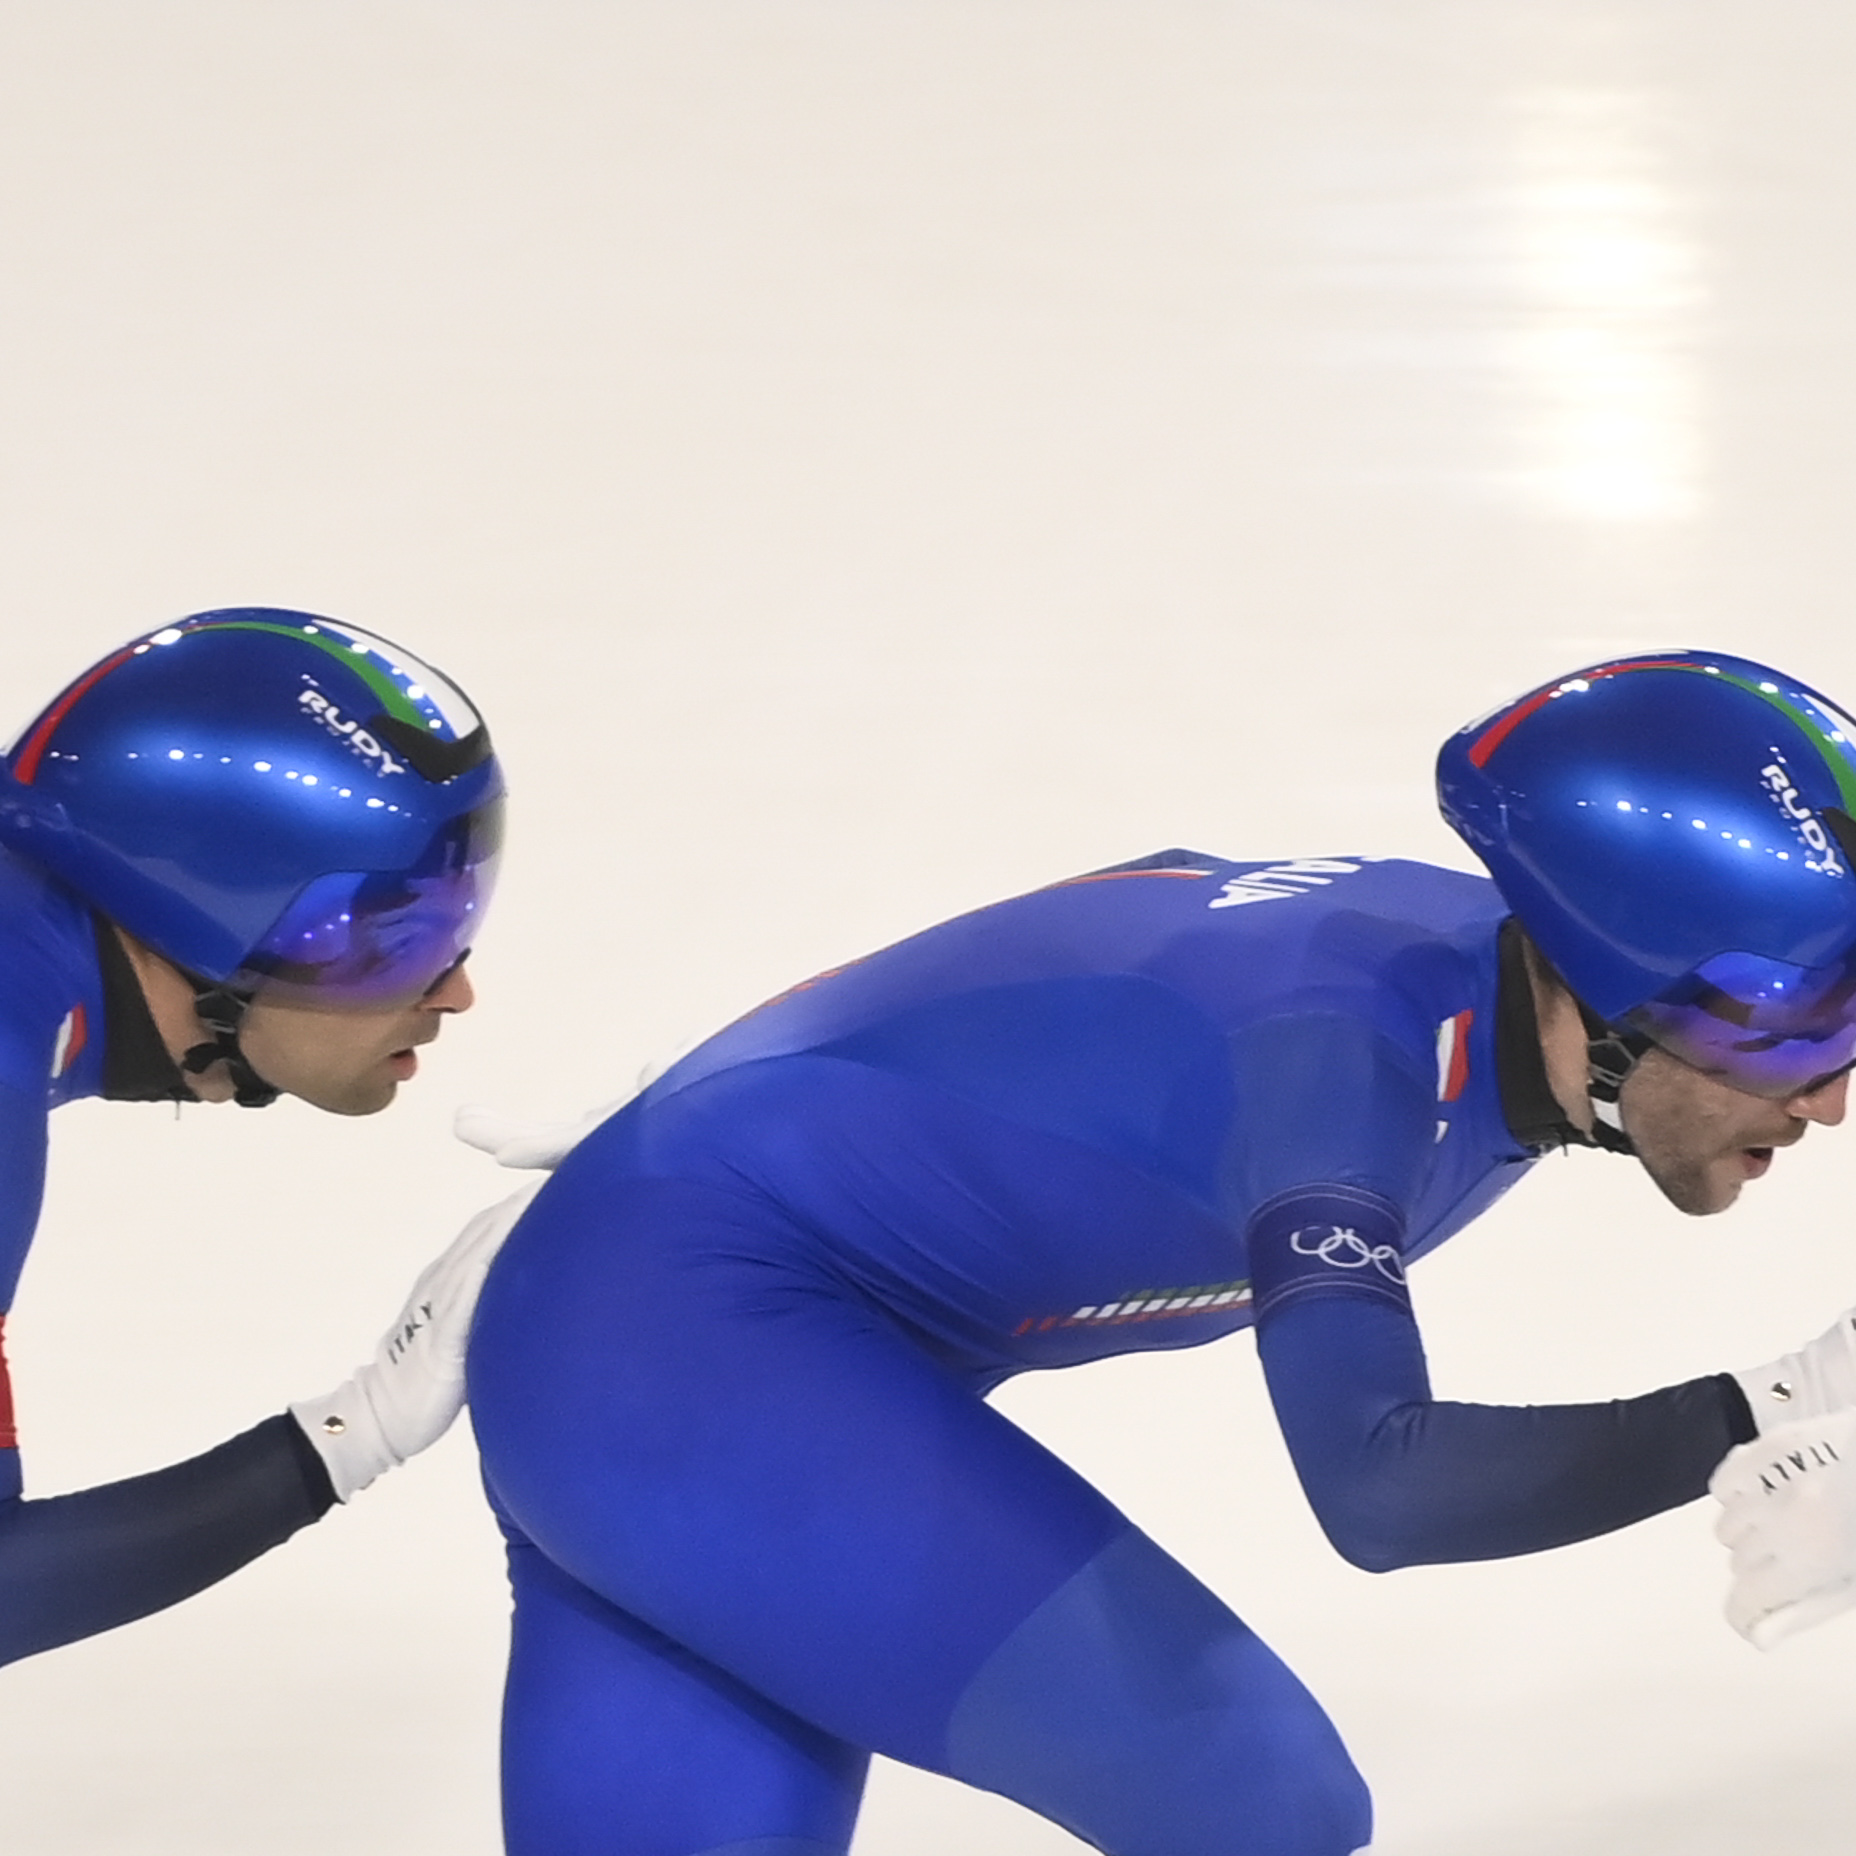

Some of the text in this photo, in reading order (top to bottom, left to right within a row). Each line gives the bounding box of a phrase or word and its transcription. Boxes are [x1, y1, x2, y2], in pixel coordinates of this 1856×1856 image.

[298, 690, 405, 775] RUDY
[1761, 764, 1845, 873] RUDY
[1207, 855, 1390, 909] ALIA
[1758, 1440, 1841, 1496] ITALY
